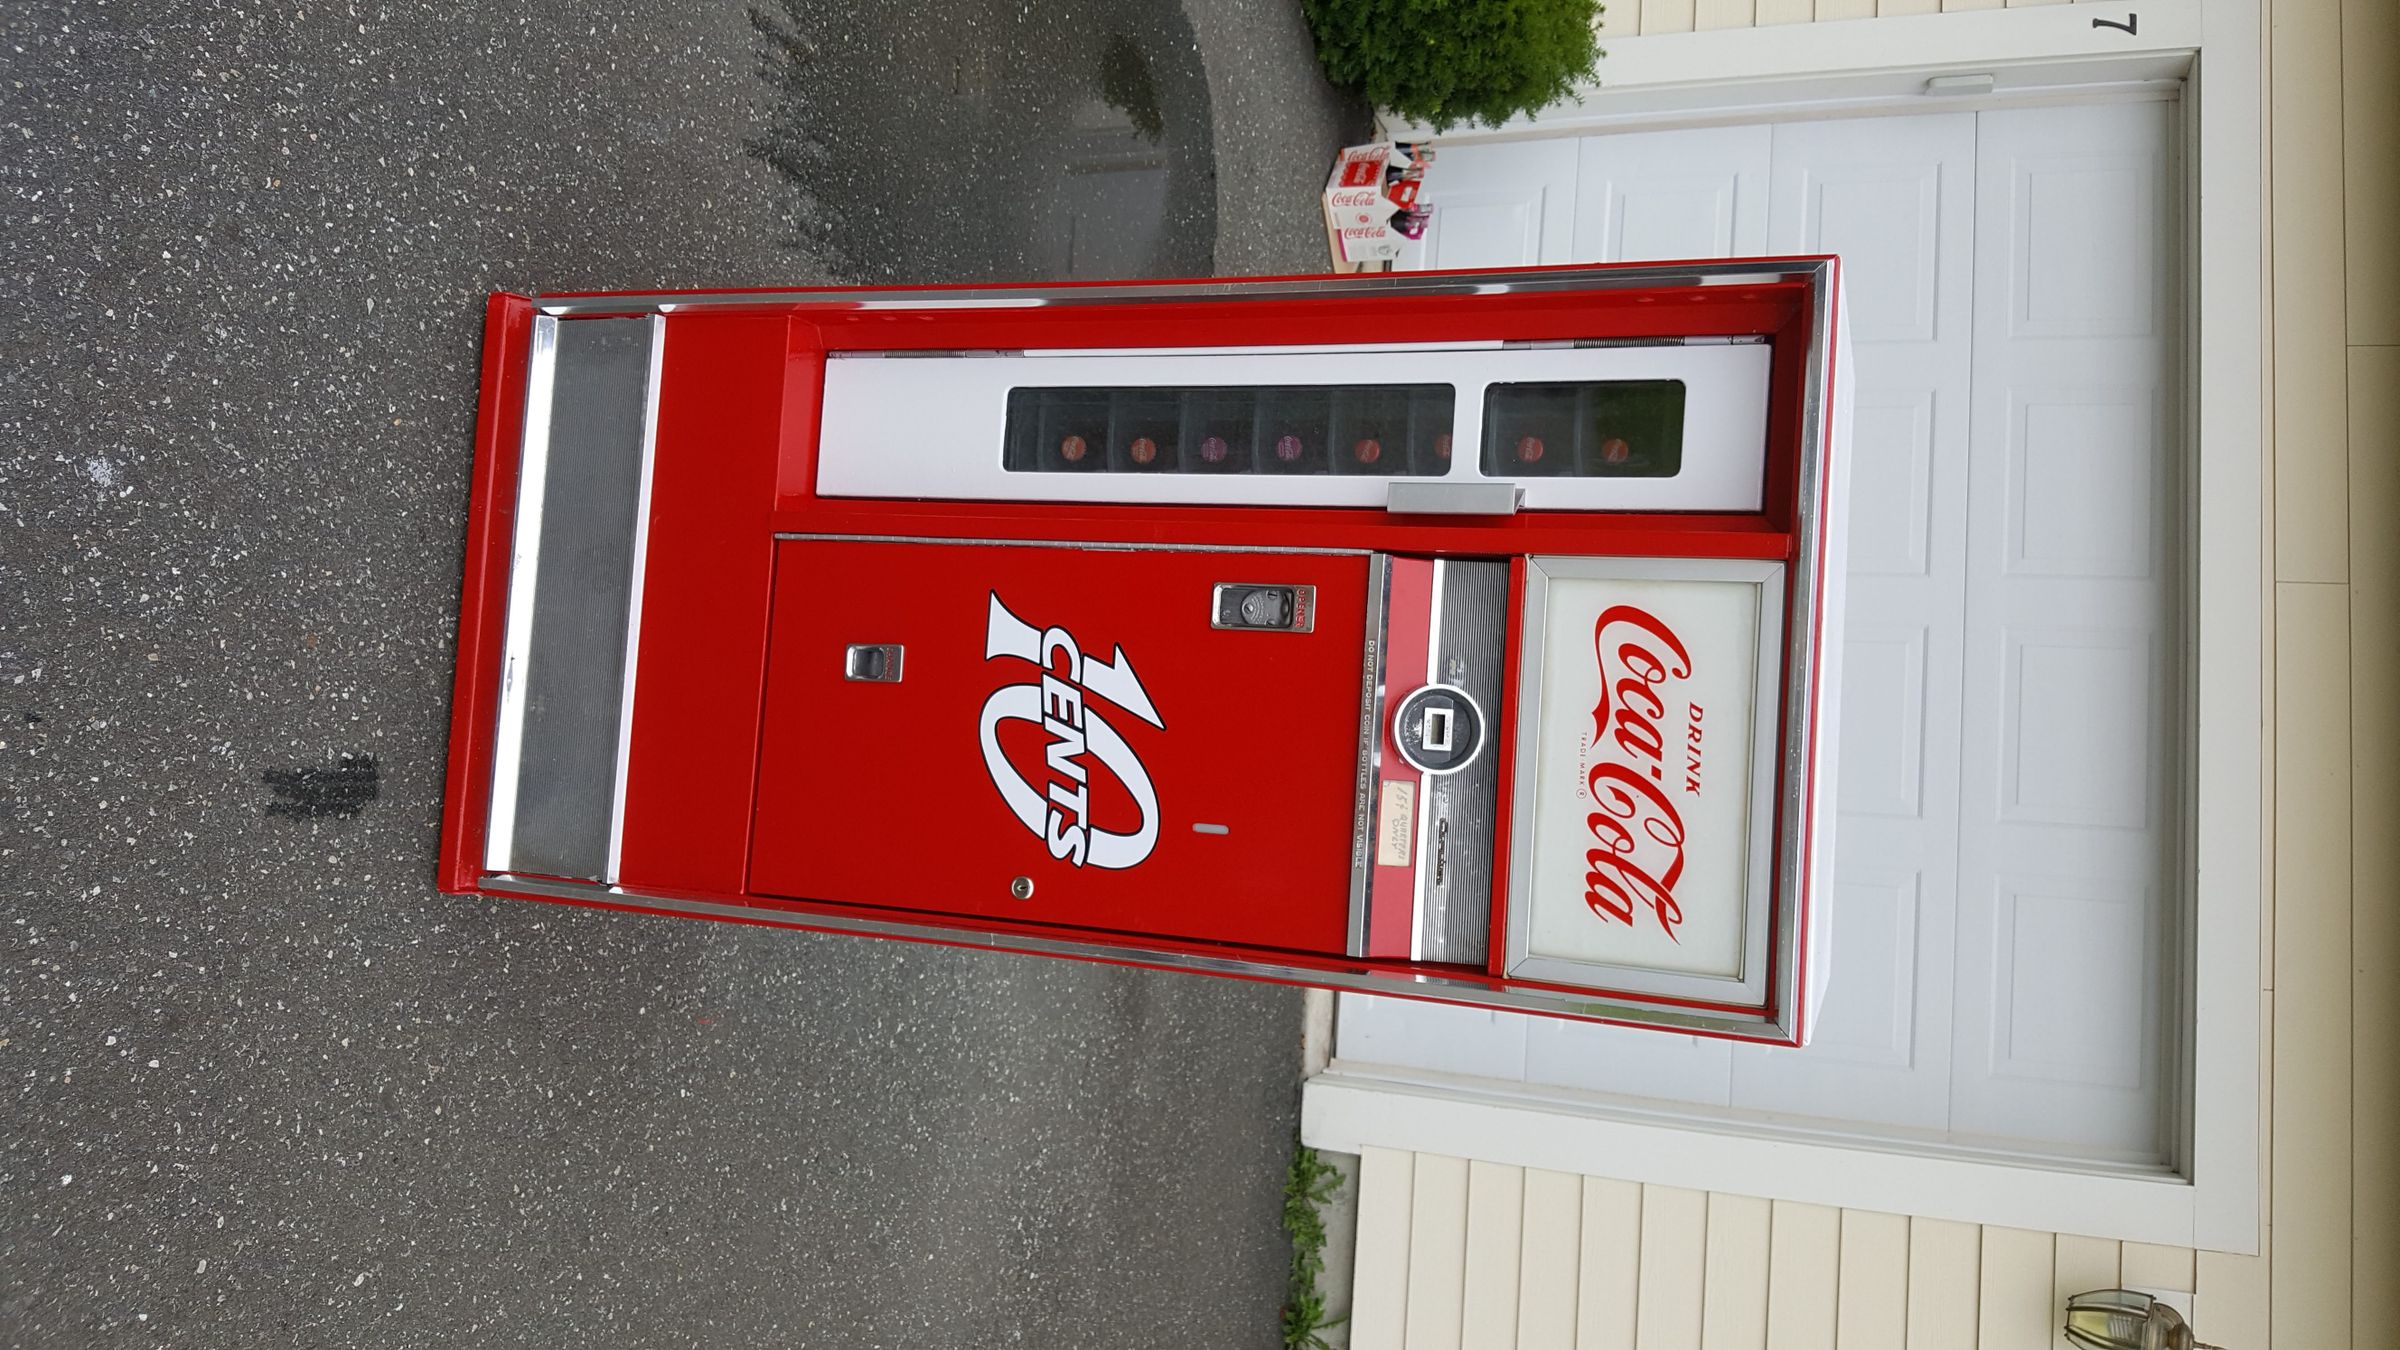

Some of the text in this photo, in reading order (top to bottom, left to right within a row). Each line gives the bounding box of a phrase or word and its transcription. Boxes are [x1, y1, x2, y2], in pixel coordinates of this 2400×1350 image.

[2092, 12, 2136, 36] 7
[1295, 588, 1307, 629] OPENER
[1367, 654, 1375, 673] NOT
[1368, 640, 1375, 653] DO
[1365, 674, 1374, 712] DEPOSIT
[978, 588, 1168, 871] 10
[1363, 714, 1371, 735] COIN
[1040, 624, 1089, 869] CENTS
[1685, 701, 1704, 798] DRINK
[1360, 749, 1368, 790] BOTTLES
[1584, 604, 1693, 946] Coca-Cola
[1358, 793, 1366, 811] ARE
[1357, 814, 1365, 832] NOT
[1391, 817, 1400, 851] ONLY
[1355, 834, 1364, 869] VISIBLE
